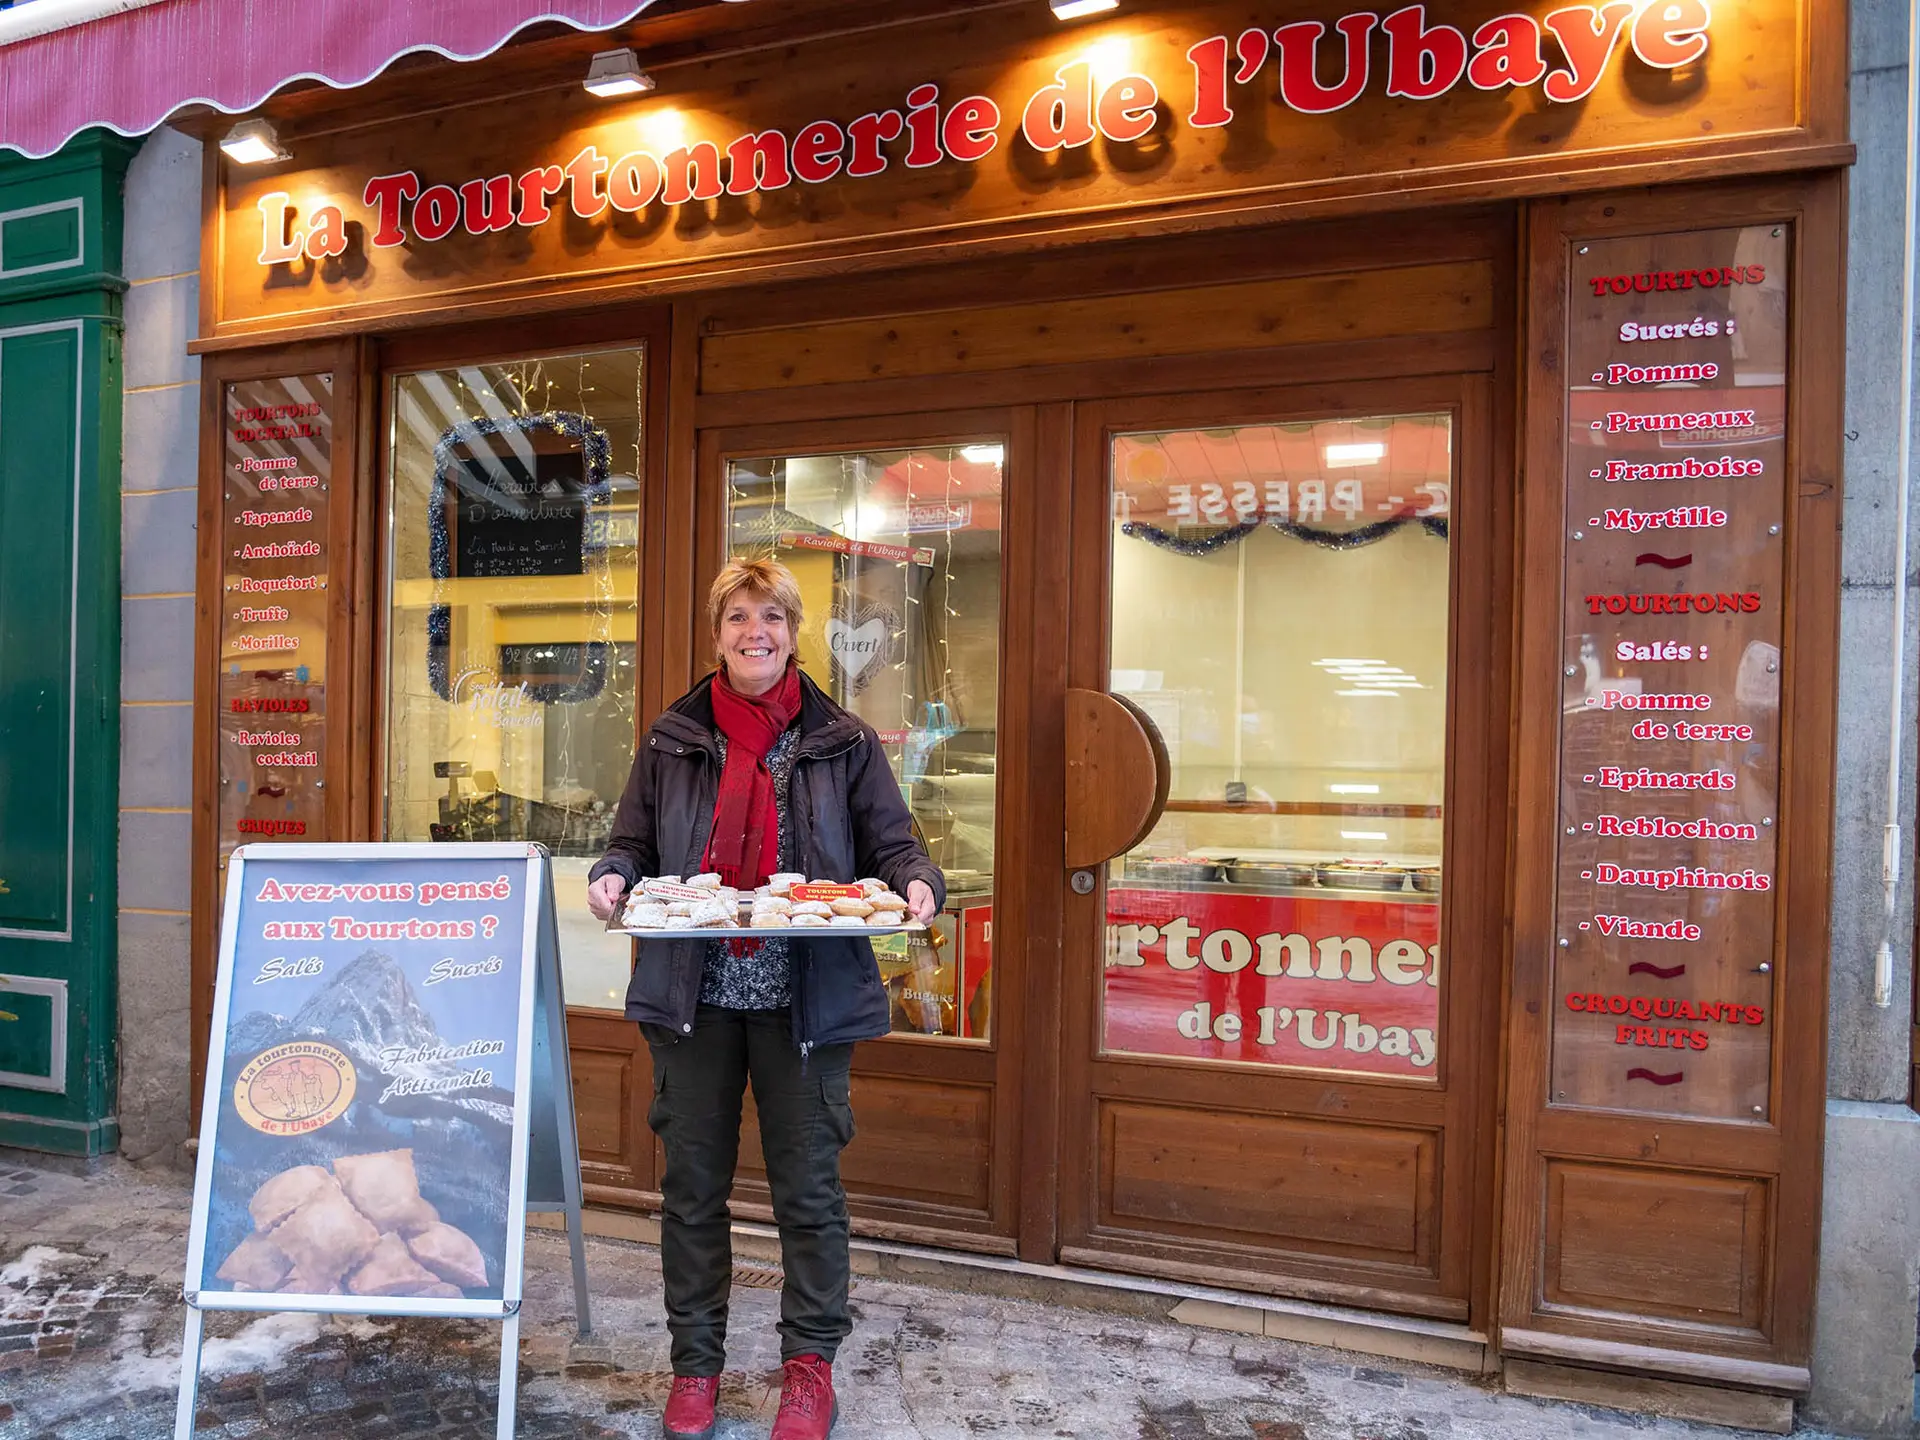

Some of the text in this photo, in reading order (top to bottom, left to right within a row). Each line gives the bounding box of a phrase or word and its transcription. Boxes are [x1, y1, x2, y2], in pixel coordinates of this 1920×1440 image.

[257, 0, 1711, 265] La Tourtonnerie de l'Ubaye
[1589, 264, 1766, 296] TOURTONS
[1620, 317, 1719, 343] Sucrés
[1607, 361, 1718, 386] Pomme
[234, 403, 320, 423] TOURTONS
[1606, 409, 1754, 434] Pruneaux
[234, 424, 313, 442] COCKTAIL
[243, 456, 297, 472] Pomme
[1604, 456, 1763, 482] Framboise
[259, 475, 318, 491] de terre
[242, 508, 312, 527] Tapenade
[1603, 505, 1727, 534] Myrtille
[241, 541, 320, 559] Anchoïade
[803, 536, 907, 559] Ravioles de l'Ubaye
[241, 575, 317, 594] Roquefort
[240, 606, 289, 622] Truffe
[1585, 592, 1760, 614] TOURTONS
[239, 635, 299, 650] Morilles
[831, 632, 878, 652] Ouvert
[1616, 640, 1692, 661] Salés
[231, 698, 309, 713] RAVIOLES
[470, 680, 528, 711] soleil
[1601, 689, 1711, 711] Pomme
[238, 731, 300, 747] Ravioles
[1632, 719, 1752, 741] de terre
[256, 751, 318, 767] cocktail
[1599, 766, 1736, 791] Epinards
[237, 818, 306, 836] CRIQUES
[1598, 815, 1757, 840] Reblochon
[1596, 864, 1771, 891] Dauphinois
[256, 875, 511, 906] Avez-vous pensé
[263, 915, 498, 940] aux Tourtons ?
[1595, 915, 1701, 941] Viande
[253, 957, 323, 985] Salés
[422, 956, 502, 986] Sucrés
[1565, 992, 1764, 1025] CROQUANTS
[1176, 1001, 1242, 1042] de
[1615, 1025, 1709, 1051] FRITS
[239, 1044, 346, 1085] La tourtonnerie
[379, 1040, 503, 1073] Fabrication
[379, 1068, 491, 1104] Artisanale
[260, 1110, 335, 1133] de l'Ubaye
